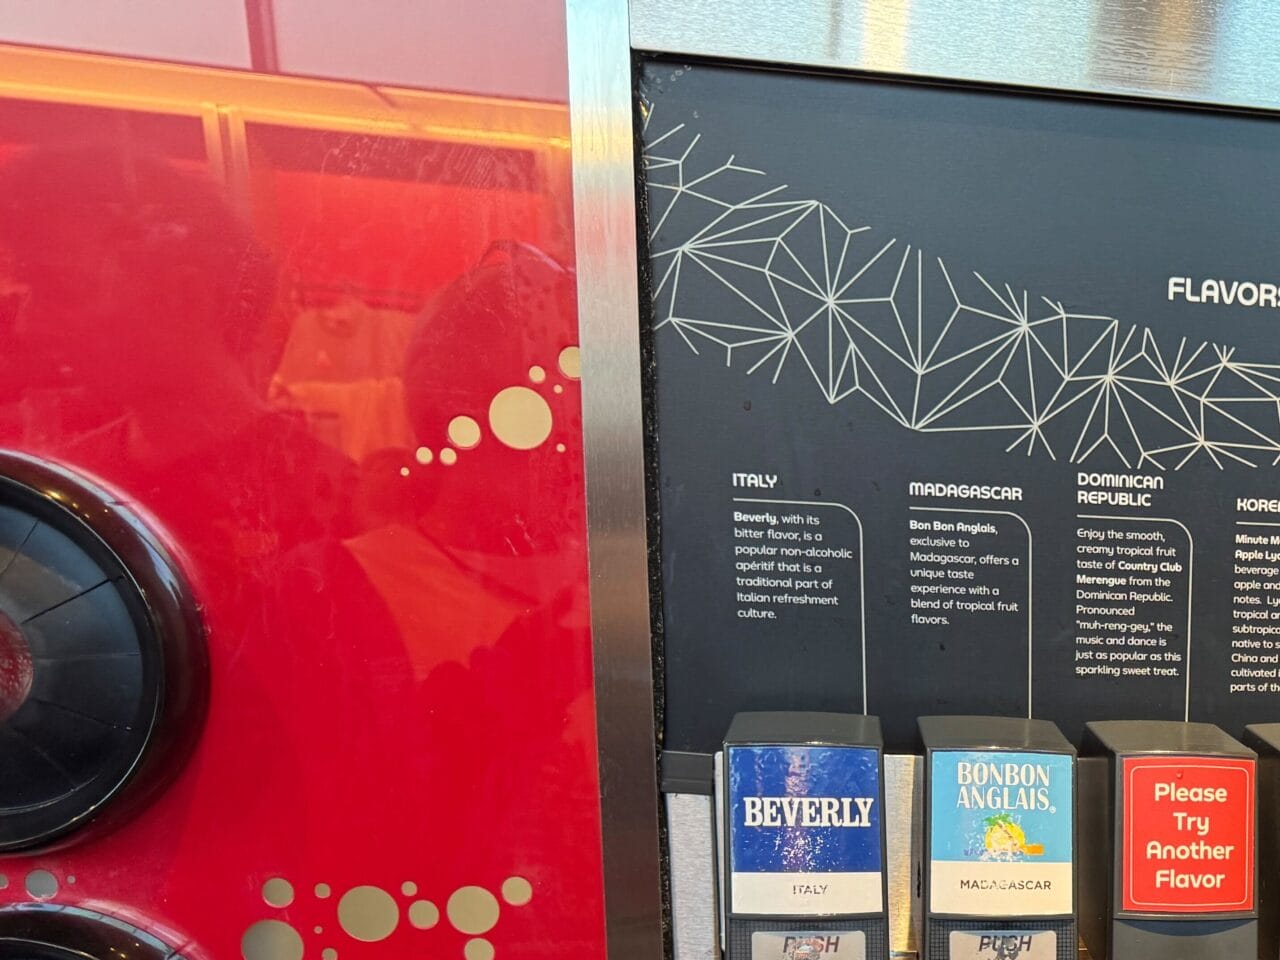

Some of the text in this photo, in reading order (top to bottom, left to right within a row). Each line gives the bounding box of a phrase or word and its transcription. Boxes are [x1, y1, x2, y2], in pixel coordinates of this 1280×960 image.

[732, 472, 778, 489] ITALY
[1077, 473, 1164, 489] DOMINICAN
[909, 482, 1023, 501] MADAGASCAR
[1077, 491, 1152, 507] REPUBLIC
[733, 511, 819, 525] Beverly, with its
[909, 519, 998, 534] Bon Bon Anglais,
[734, 527, 822, 541] bitter flavor, is a
[1076, 528, 1165, 542] Enjoy the smooth,
[909, 536, 969, 547] exclusive to
[734, 544, 852, 558] popular non-alcoholic
[910, 551, 1019, 565] Madagascar, offers a
[1076, 545, 1176, 557] creamy tropical fruit
[1234, 549, 1264, 561] Apple
[735, 560, 774, 572] apéritif
[777, 561, 800, 572] that
[802, 562, 812, 572] is
[910, 567, 974, 579] unique taste
[1076, 559, 1182, 573] taste of Country Club
[1234, 564, 1279, 577] beverage
[735, 576, 832, 590] traditional part of
[1076, 574, 1171, 587] Merengue from the
[1233, 579, 1261, 590] apple
[910, 584, 966, 595] experience
[968, 585, 990, 595] with
[1076, 589, 1173, 603] Dominican Republic.
[736, 592, 838, 605] Italian refreshment
[910, 598, 1018, 612] blend of tropical fruit
[737, 607, 776, 618] culture.
[910, 613, 949, 624] flavors.
[957, 762, 1050, 787] BONBON
[1154, 782, 1228, 803] Please
[743, 796, 874, 827] BEVERLY
[1173, 812, 1210, 836] Try
[1146, 841, 1235, 860] Another
[960, 880, 1052, 890] MADAGASCAR
[1155, 869, 1226, 889] Flavor
[793, 885, 828, 895] ITALY
